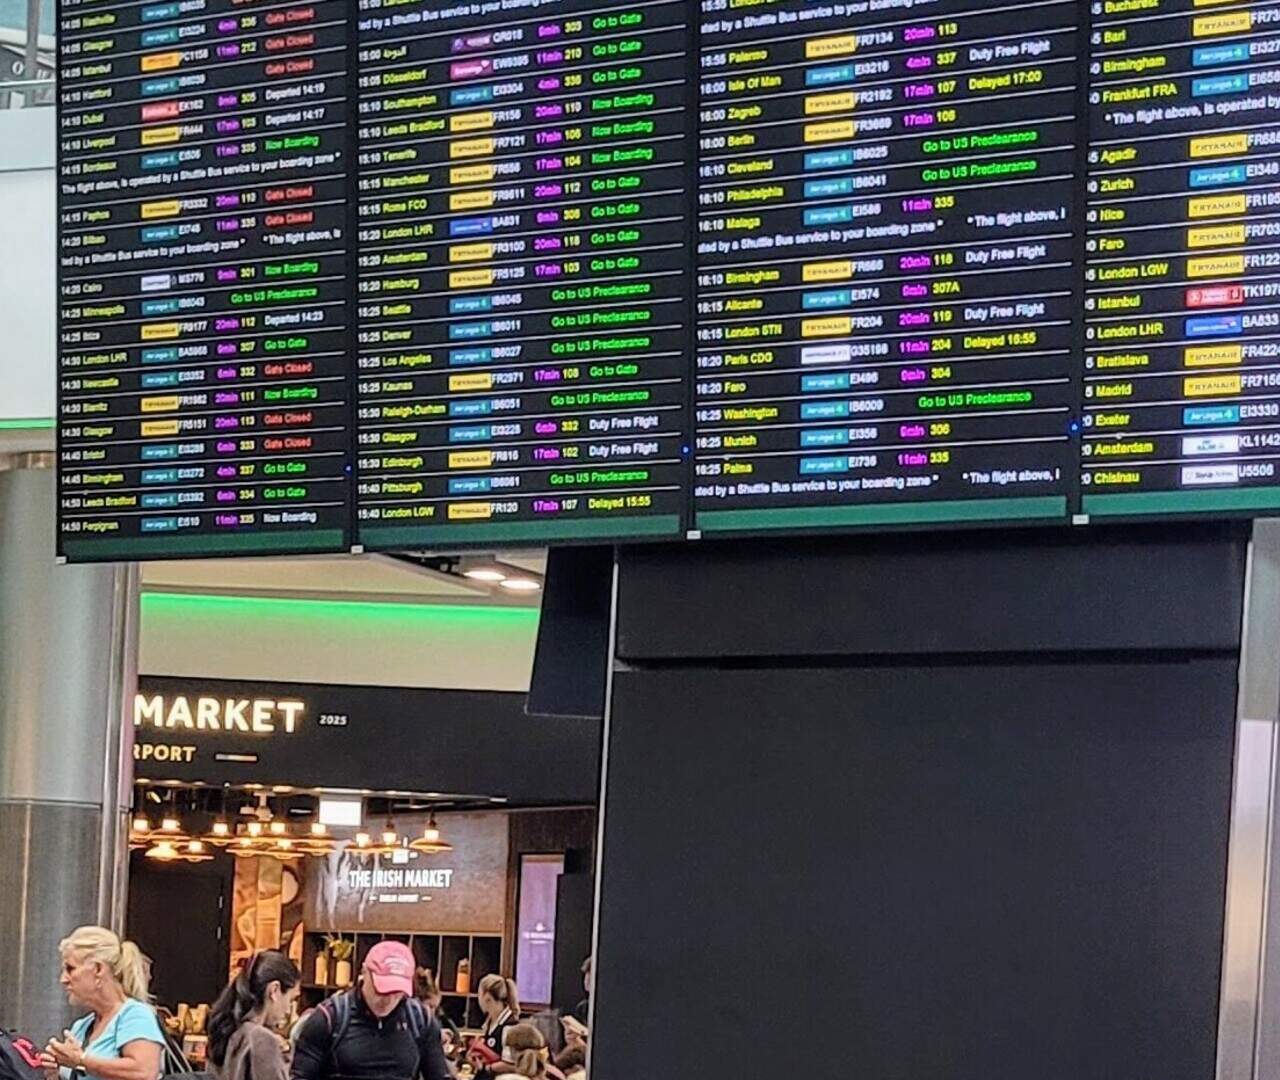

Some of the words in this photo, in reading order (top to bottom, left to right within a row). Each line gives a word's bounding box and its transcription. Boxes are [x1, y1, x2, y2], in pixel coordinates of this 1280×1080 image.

[1103, 56, 1166, 73] Birmingham
[1153, 84, 1178, 96] FRA
[923, 142, 938, 152] Go
[940, 141, 950, 149] to
[1098, 295, 1141, 309] Istanbul
[1097, 325, 1137, 338] London
[1139, 323, 1164, 335] LHR
[134, 694, 305, 733] MARKET
[320, 715, 348, 726] 2025
[349, 870, 370, 888] THE
[372, 869, 402, 888] IRISH
[404, 869, 453, 888] MARKET
